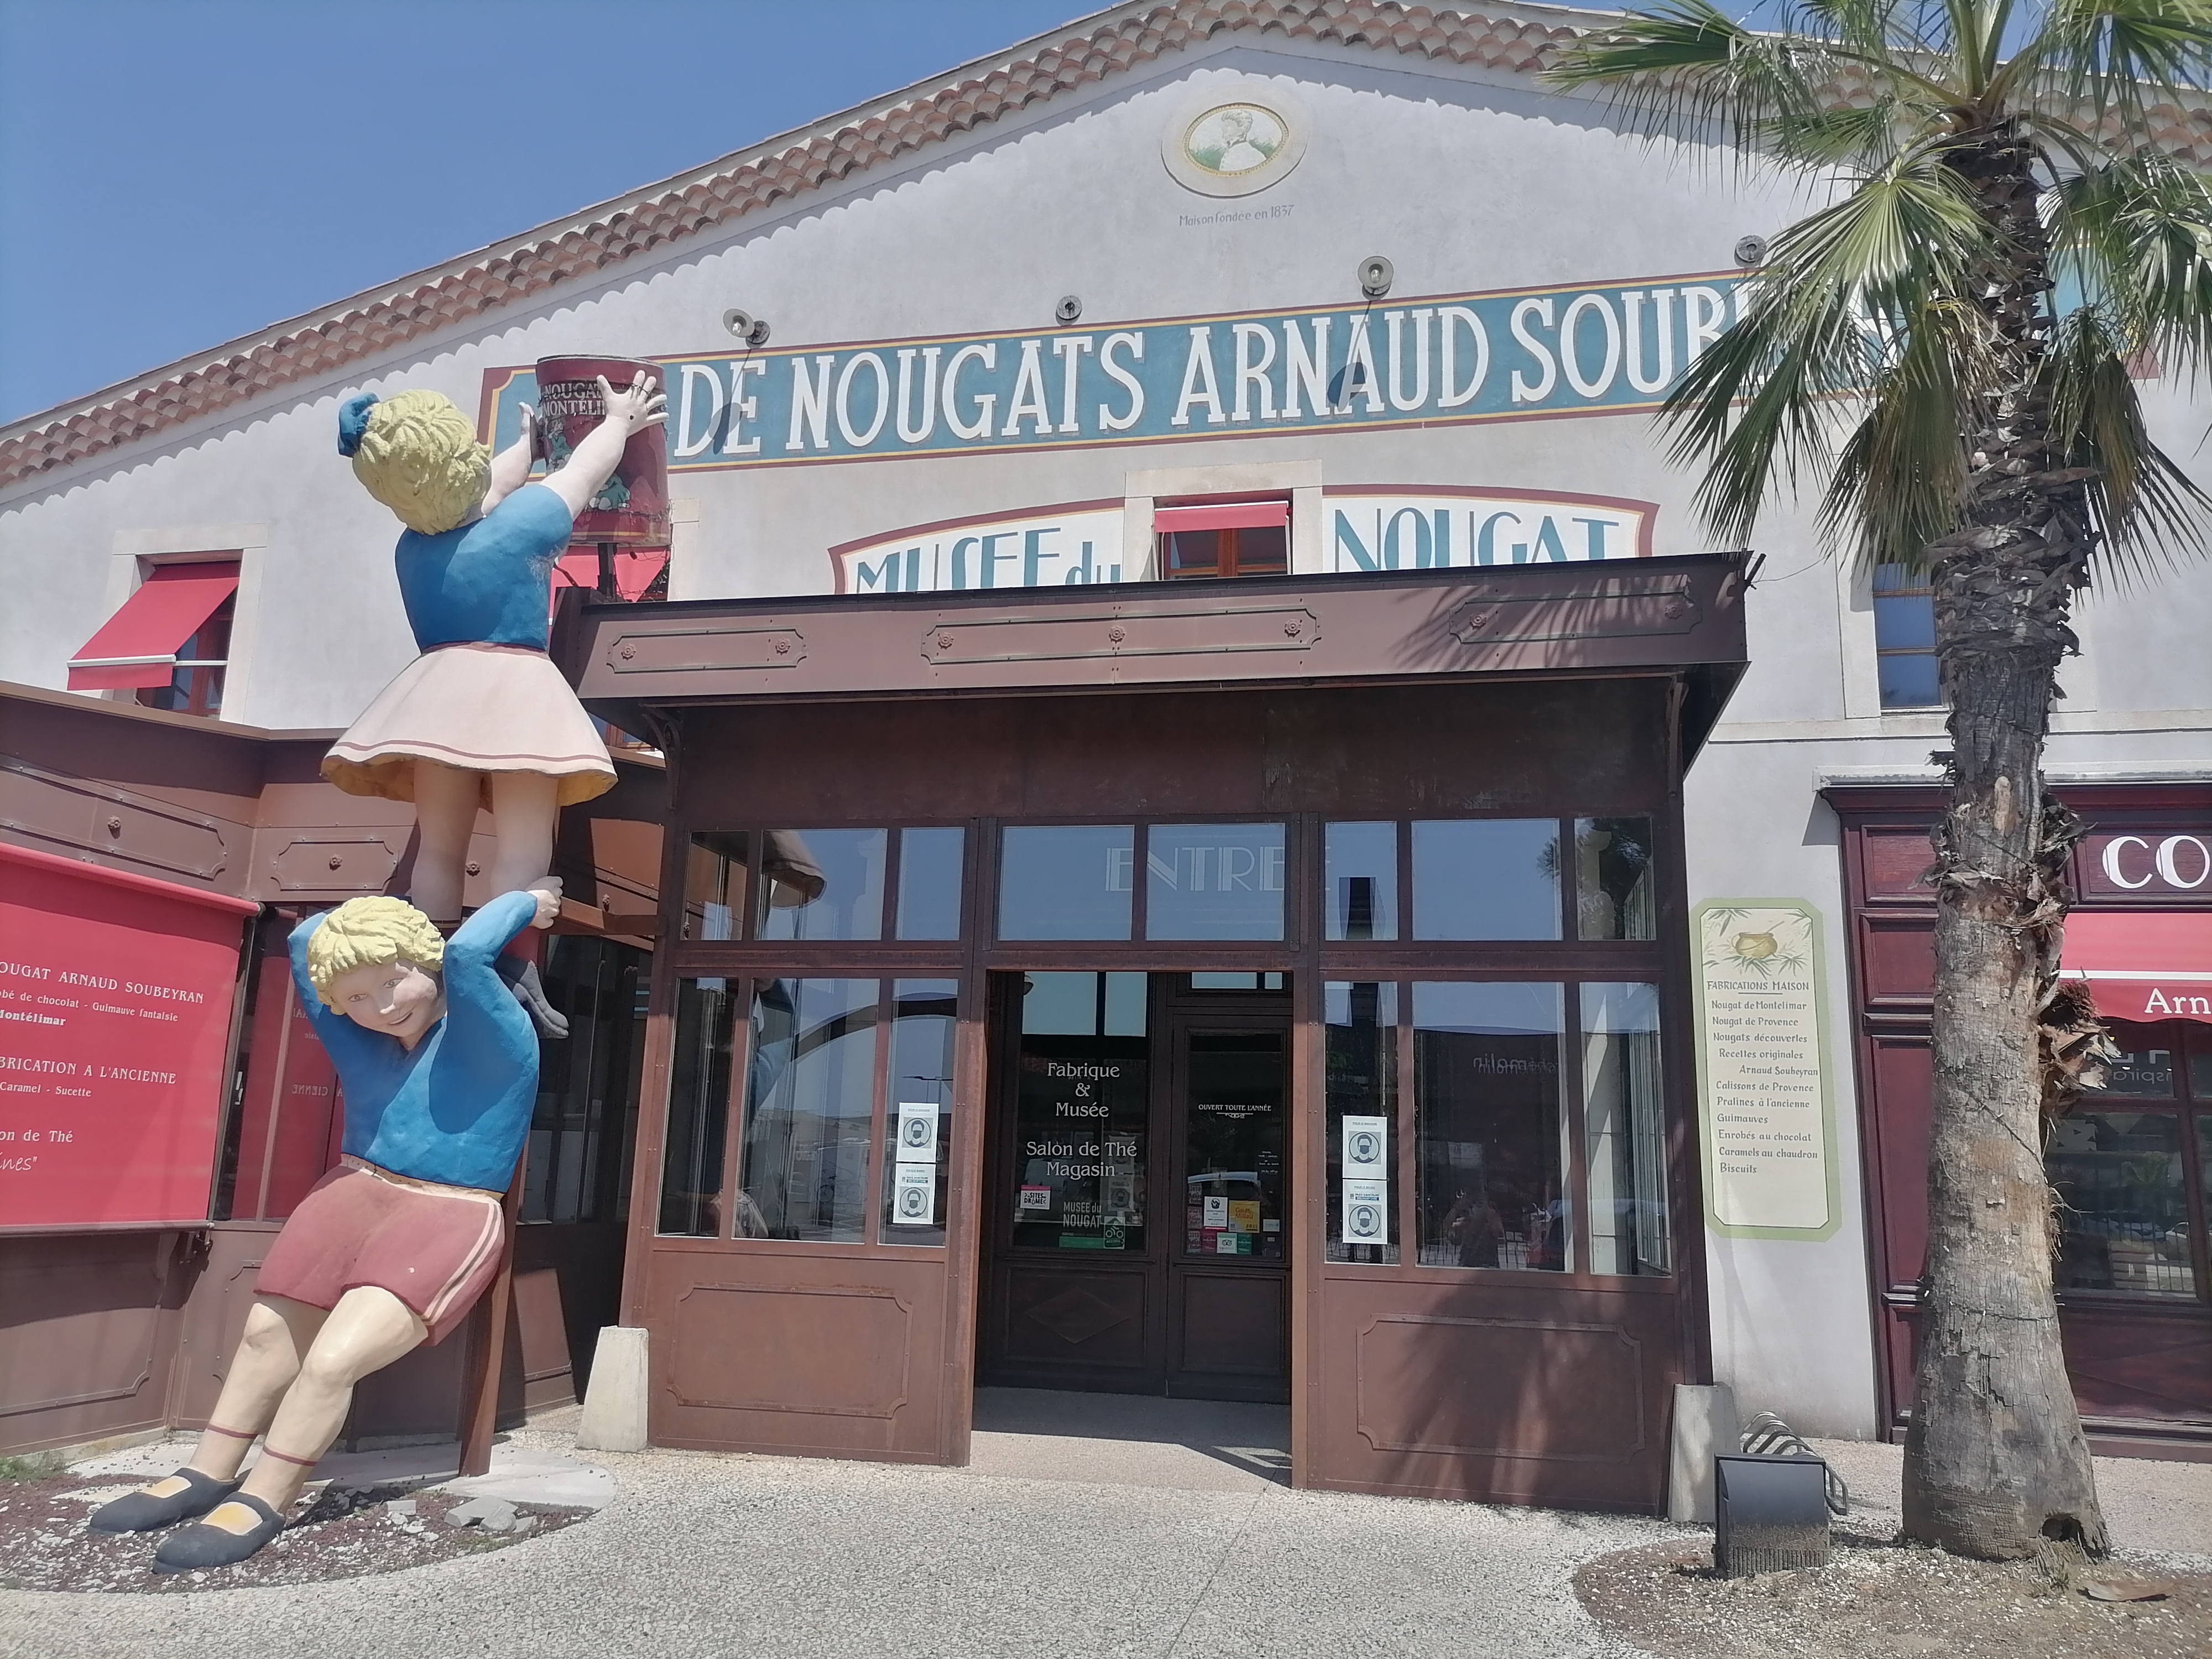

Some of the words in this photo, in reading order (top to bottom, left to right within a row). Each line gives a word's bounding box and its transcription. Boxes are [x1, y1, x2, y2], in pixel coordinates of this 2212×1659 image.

[1179, 215, 1213, 227] Maison
[1215, 211, 1251, 223] fondée
[1254, 211, 1268, 220] en
[1270, 205, 1295, 218] 1837
[674, 358, 766, 458] DE
[785, 331, 1145, 451] NOUGATS
[1170, 305, 1490, 426] ARNAUD
[1510, 282, 1770, 404] SOUB
[1334, 507, 1620, 573] NOUGAT
[2102, 834, 2211, 889] CO
[58, 971, 118, 990] ARNAUD
[125, 982, 204, 1004] SOUBEYRAN
[1707, 980, 1768, 990] FABRICATIONS
[1772, 980, 1809, 990] MAISON
[0, 989, 14, 999] bé
[20, 992, 32, 1002] de
[37, 995, 80, 1009] chocolat
[92, 1002, 135, 1016] Guimauve
[139, 1008, 178, 1022] fantaisie
[1711, 1000, 1742, 1012] Nougat
[1744, 1001, 1755, 1010] de
[2144, 987, 2212, 1015] Arn
[1712, 1016, 1742, 1029] Nougat
[1745, 1018, 1756, 1026] de
[1757, 1017, 1799, 1026] Provence
[1713, 1032, 1750, 1044] Nougats
[1754, 1033, 1808, 1043] découvertes
[1719, 1048, 1757, 1058] Recettes
[1759, 1050, 1804, 1061] originales
[84, 1065, 93, 1076] A
[100, 1066, 176, 1084] L'ANCIENNE
[1047, 1062, 1120, 1081] Fabrique
[1739, 1065, 1772, 1074] Arnaud
[1775, 1066, 1818, 1078] Soubeyran
[0, 1081, 41, 1093] Caramel
[55, 1086, 92, 1097] Sucette
[1075, 1082, 1091, 1097] &
[1716, 1080, 1756, 1091] Calissons
[1759, 1082, 1770, 1091] de
[1772, 1082, 1814, 1092] Provence
[1247, 1103, 1272, 1112] L'ANNÉE
[1717, 1096, 1755, 1107] Pralines
[1759, 1097, 1764, 1107] à
[1767, 1098, 1810, 1108] l'ancienne
[1055, 1102, 1109, 1117] Musée
[1717, 1113, 1768, 1124] Guimauves
[23, 1129, 40, 1141] de
[49, 1130, 74, 1143] Thé
[1718, 1129, 1756, 1140] Enrobés
[1773, 1132, 1812, 1141] chocolat
[1026, 1141, 1073, 1156] Salon
[1078, 1141, 1100, 1156] de
[1104, 1141, 1138, 1157] Thé
[1719, 1146, 1760, 1157] Caramels
[1776, 1148, 1818, 1159] chaudron
[1046, 1161, 1116, 1181] Magasin
[1720, 1162, 1757, 1173] Biscuits
[1092, 1202, 1102, 1213] du
[1063, 1214, 1102, 1229] NOUGAT
